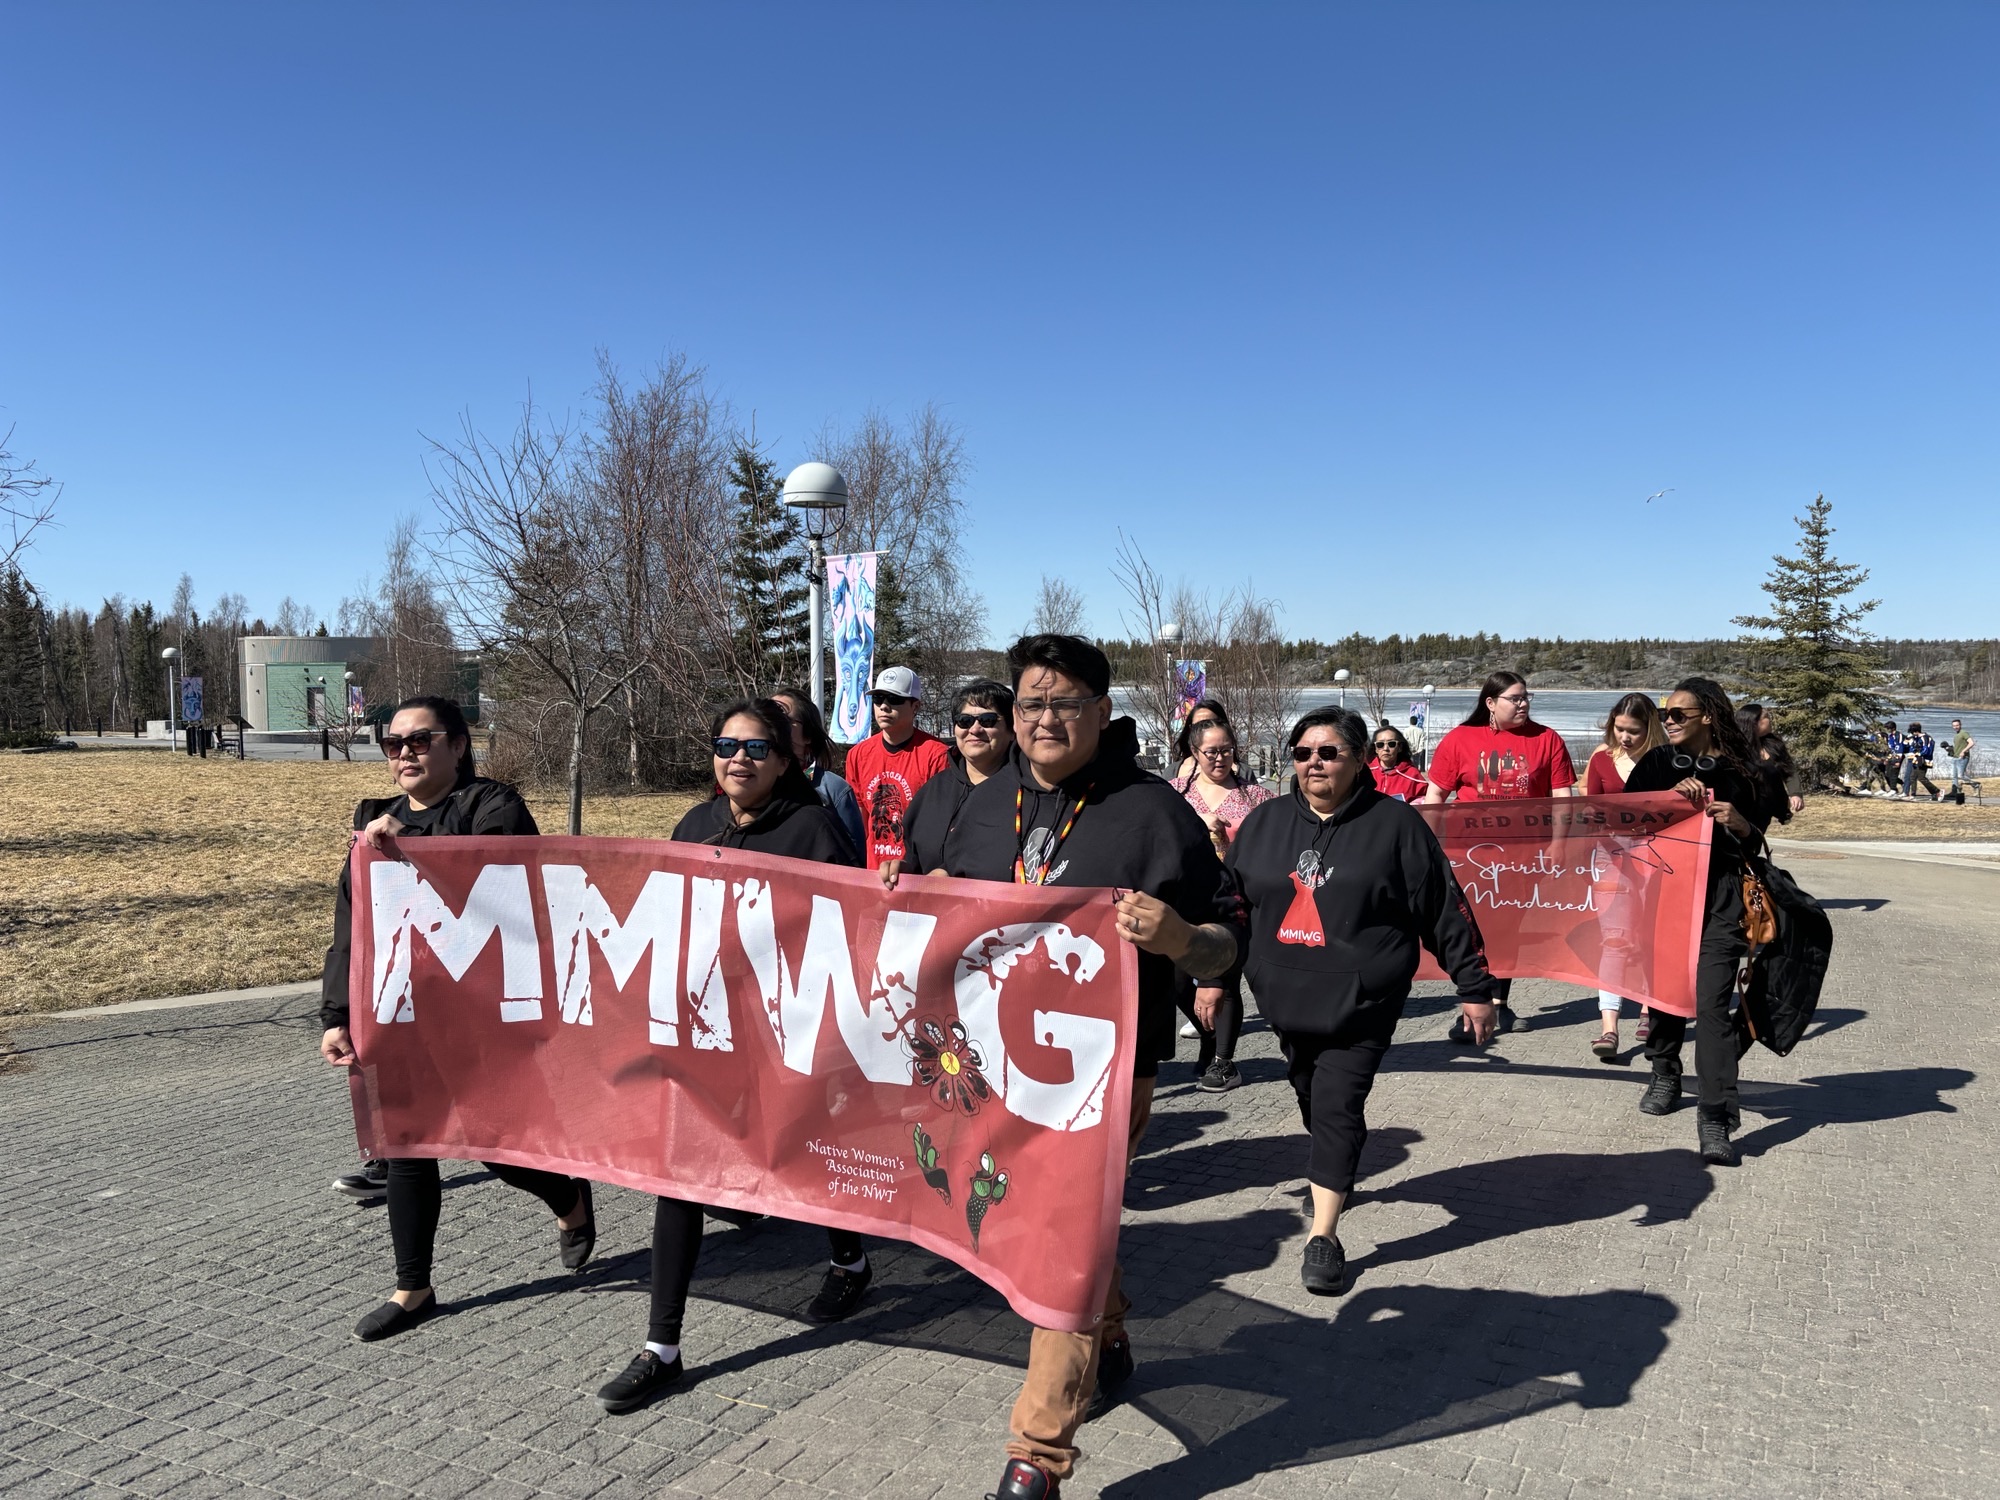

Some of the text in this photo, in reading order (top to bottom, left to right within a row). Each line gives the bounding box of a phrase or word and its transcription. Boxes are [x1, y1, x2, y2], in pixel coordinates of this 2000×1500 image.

[868, 774, 881, 791] MORE
[882, 771, 902, 781] STOLEN
[1464, 811, 1675, 829] RED DRESS DAY
[874, 843, 902, 856] MMIWG
[1466, 843, 1606, 894] Spirits of
[1462, 881, 1599, 912] Murdered
[1280, 928, 1321, 942] MMIWG
[370, 861, 1116, 1132] MMIWG
[806, 1139, 905, 1171] Native Women's
[825, 1159, 895, 1184] Association
[828, 1177, 898, 1203] of the NWT
